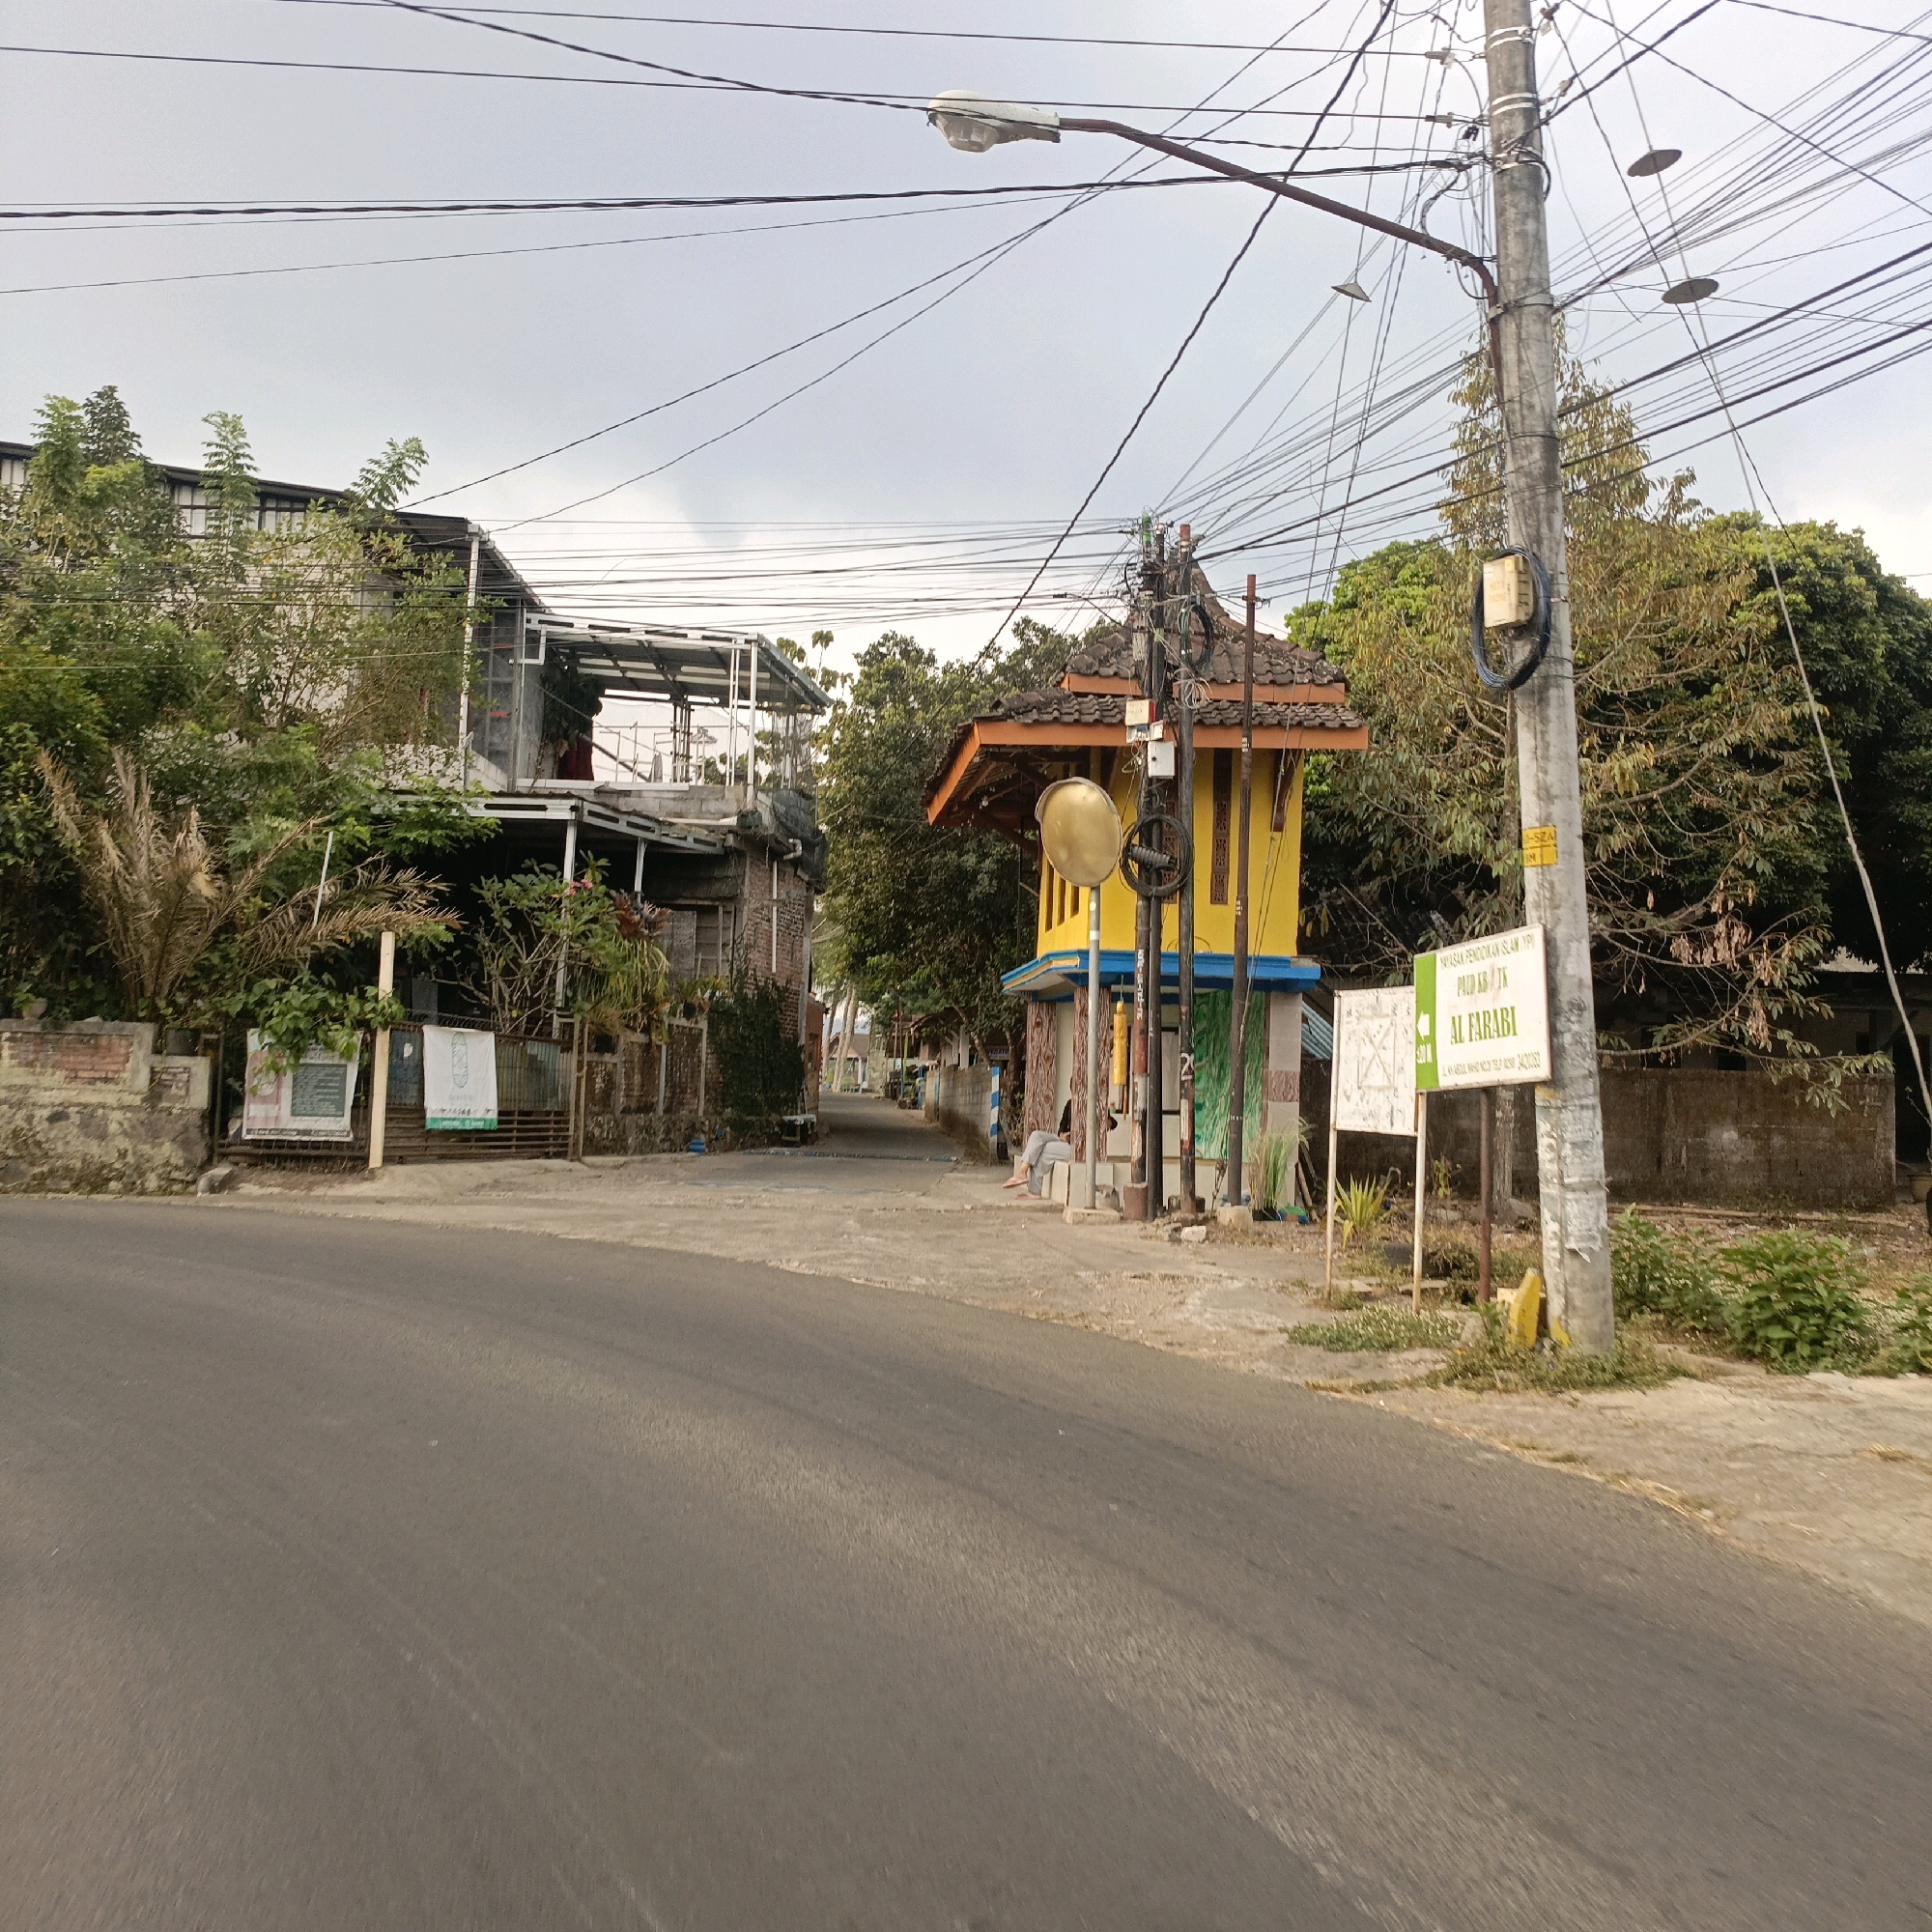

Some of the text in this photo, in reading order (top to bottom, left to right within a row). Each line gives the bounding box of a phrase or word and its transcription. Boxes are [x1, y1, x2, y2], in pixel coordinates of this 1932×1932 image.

[1440, 952, 1464, 970] YAYASAN
[1465, 943, 1499, 963] PENDIDIKAN
[1501, 936, 1519, 954] ISLAM
[1457, 966, 1508, 997] PAUD KB TK
[1450, 1006, 1518, 1045] AL FARABI
